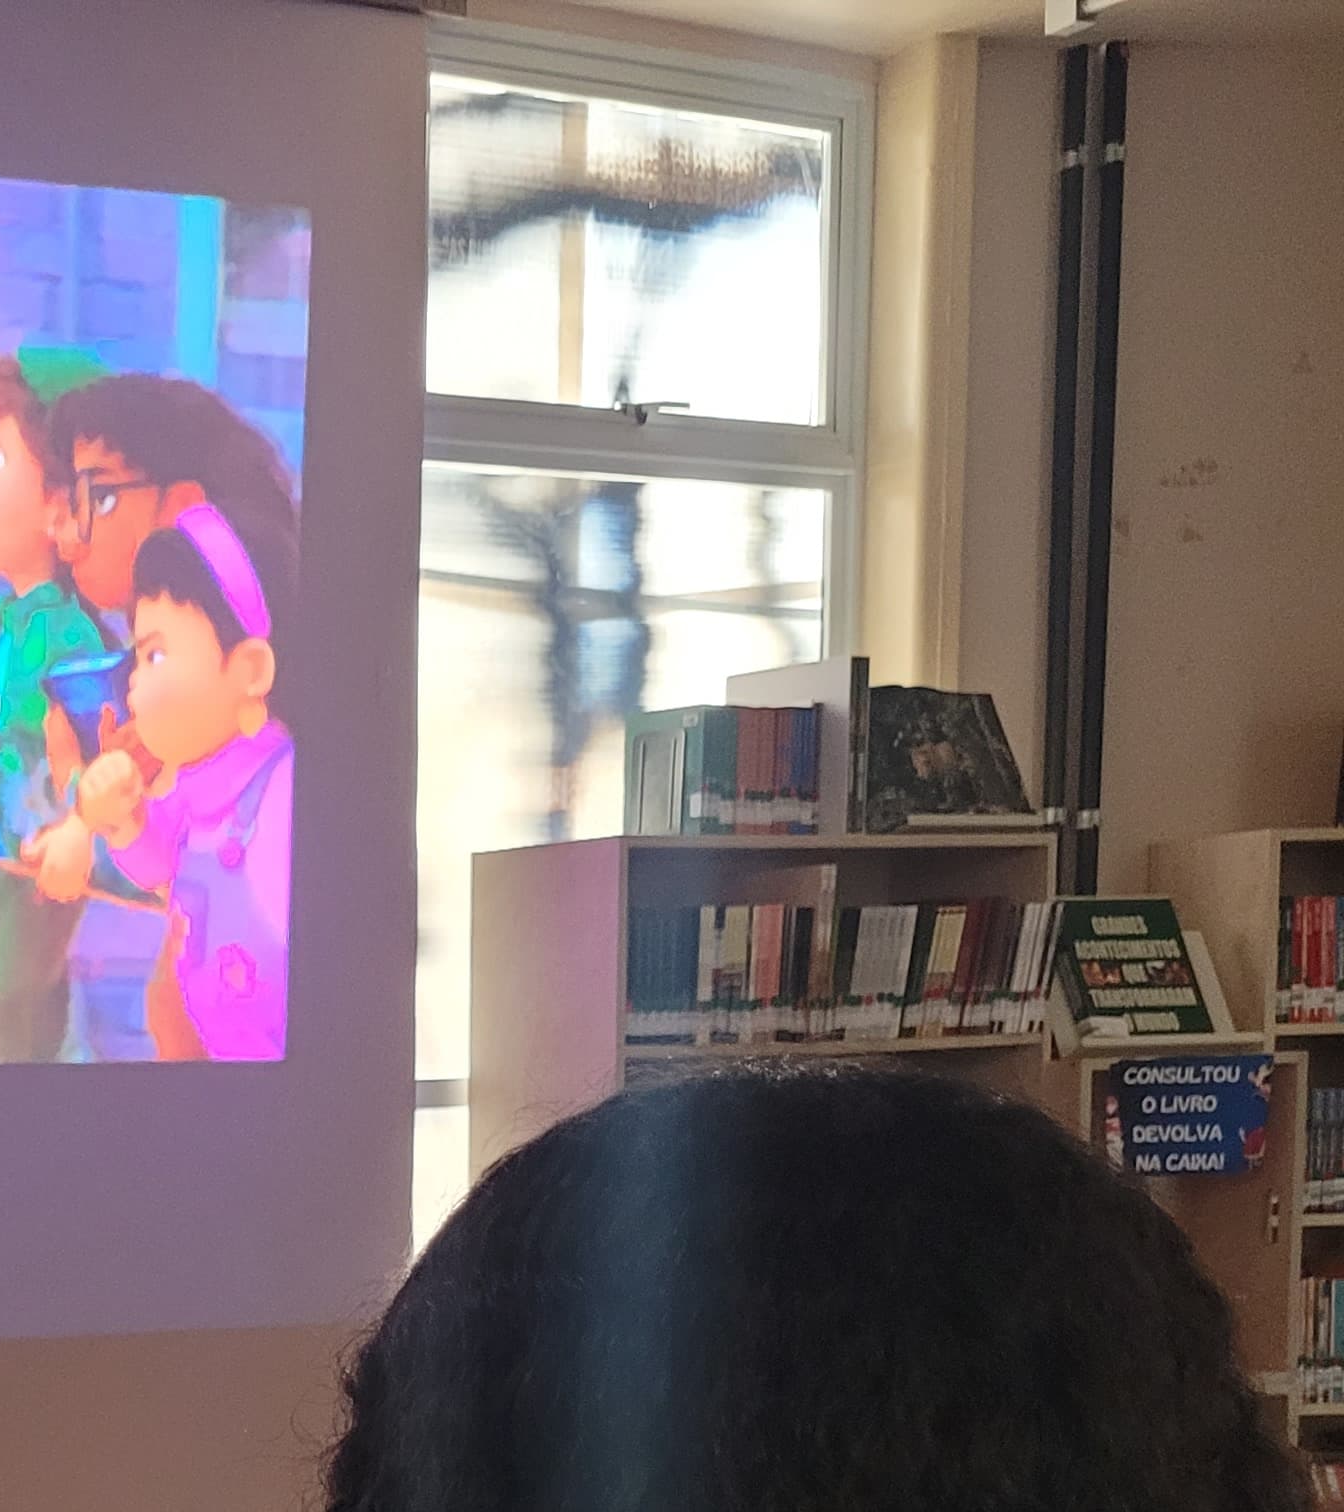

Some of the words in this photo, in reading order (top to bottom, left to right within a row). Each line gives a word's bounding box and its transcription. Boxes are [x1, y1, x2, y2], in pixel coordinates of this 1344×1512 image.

[1123, 1065, 1241, 1085] CONSULTOU
[1141, 1095, 1157, 1114] O
[1160, 1094, 1218, 1114] LIVRO
[1132, 1123, 1223, 1144] DEVOLVA
[1135, 1153, 1162, 1173] NA
[1165, 1152, 1226, 1172] CAIXA!
